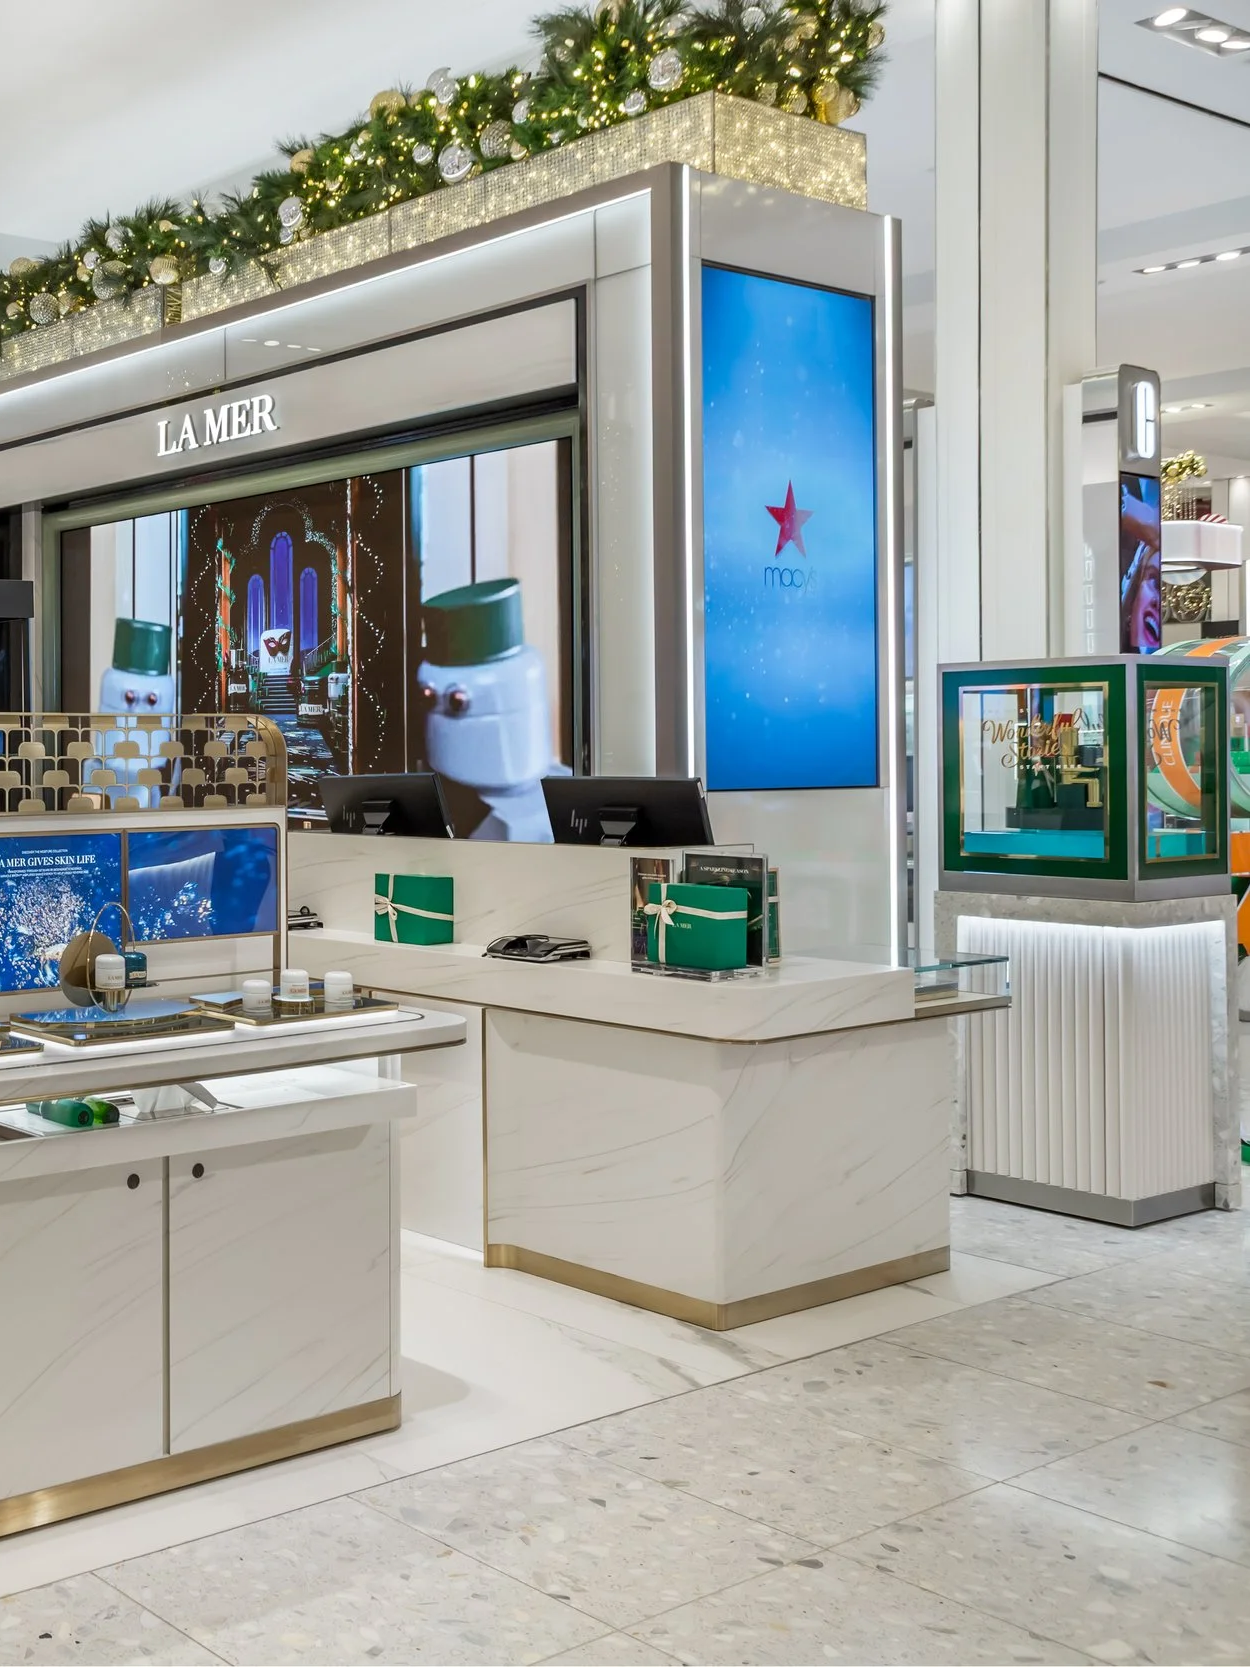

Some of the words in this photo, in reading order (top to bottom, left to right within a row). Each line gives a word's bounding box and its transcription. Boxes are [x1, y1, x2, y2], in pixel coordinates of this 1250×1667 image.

[157, 413, 200, 457] LA
[203, 394, 279, 446] MER
[6, 858, 26, 868] MER
[27, 856, 54, 867] GIVES
[55, 855, 76, 866] SKIN
[76, 854, 96, 864] LIFE
